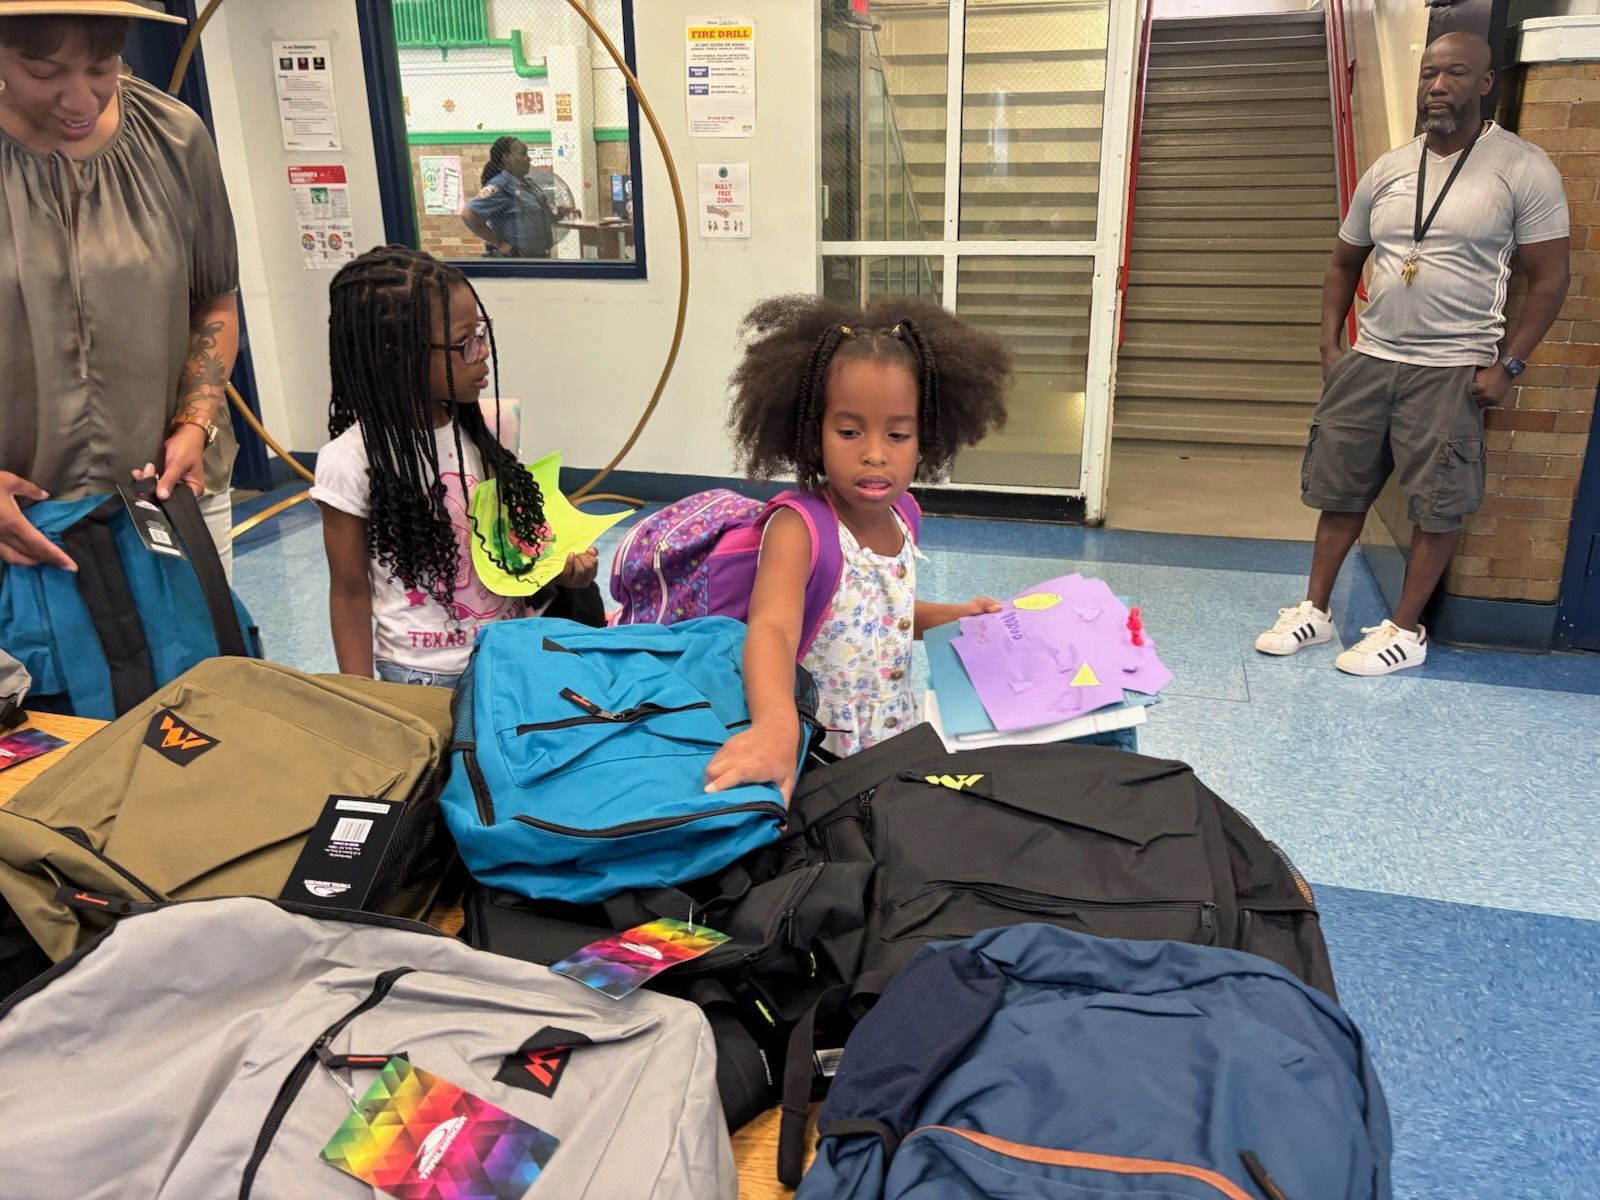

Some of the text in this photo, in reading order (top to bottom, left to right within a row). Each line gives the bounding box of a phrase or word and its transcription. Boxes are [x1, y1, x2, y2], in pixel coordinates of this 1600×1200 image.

[691, 30, 750, 38] FIRE DRILL
[408, 631, 466, 648] TEXAS
[418, 1115, 468, 1180] TRAILMAKER
